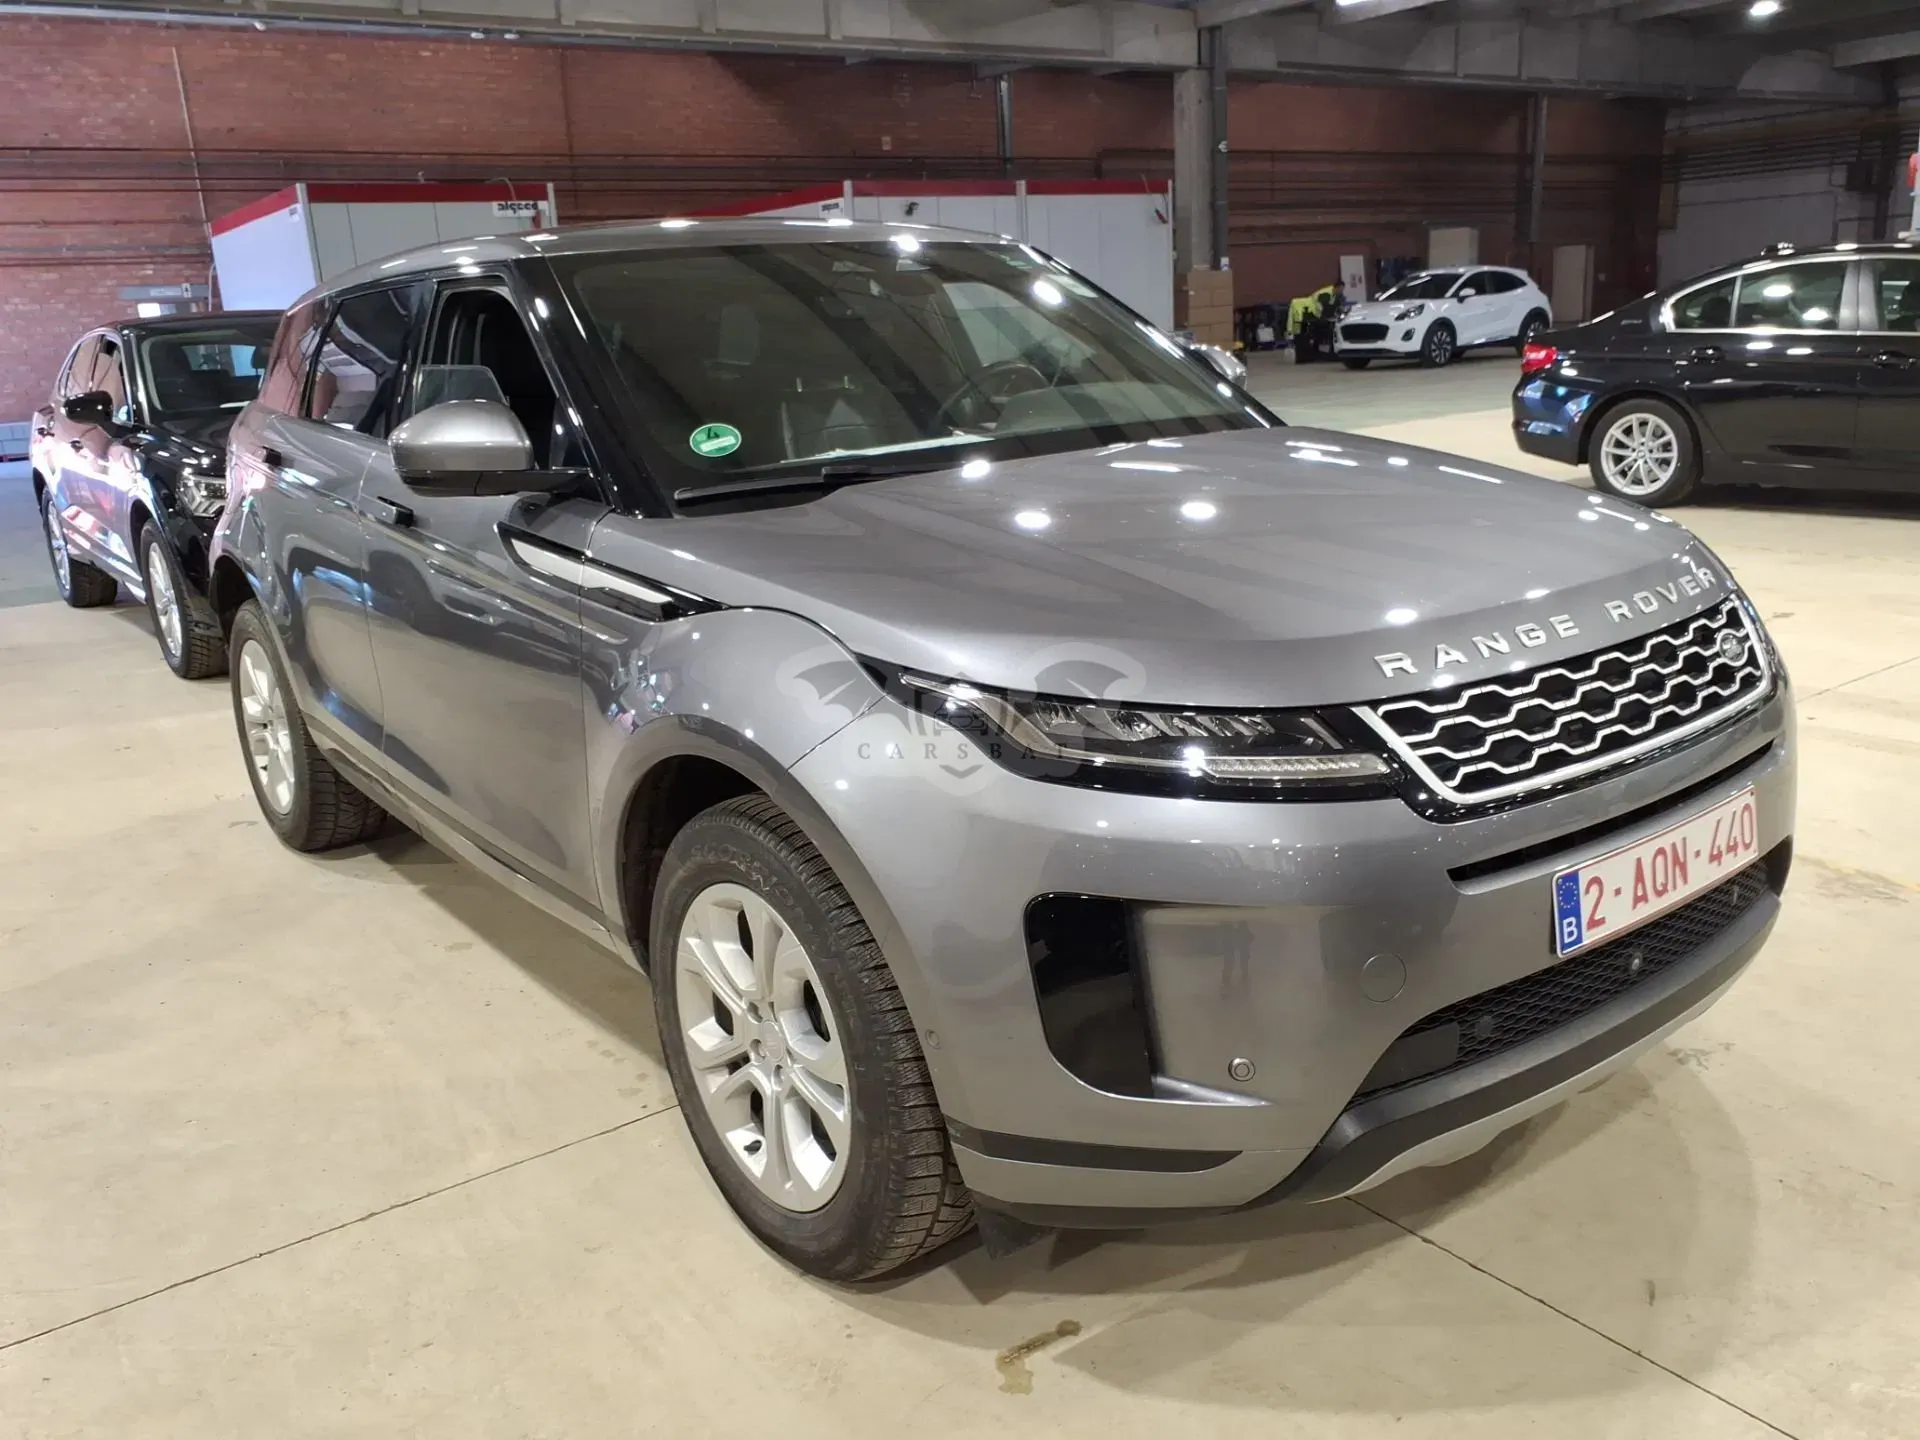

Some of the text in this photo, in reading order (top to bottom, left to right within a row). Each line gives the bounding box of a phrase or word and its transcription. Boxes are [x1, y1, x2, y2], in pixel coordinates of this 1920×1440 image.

[1374, 566, 1717, 679] RANGE ROVER
[1583, 802, 1755, 932] 2-AQN-440
[1562, 916, 1579, 944] B
